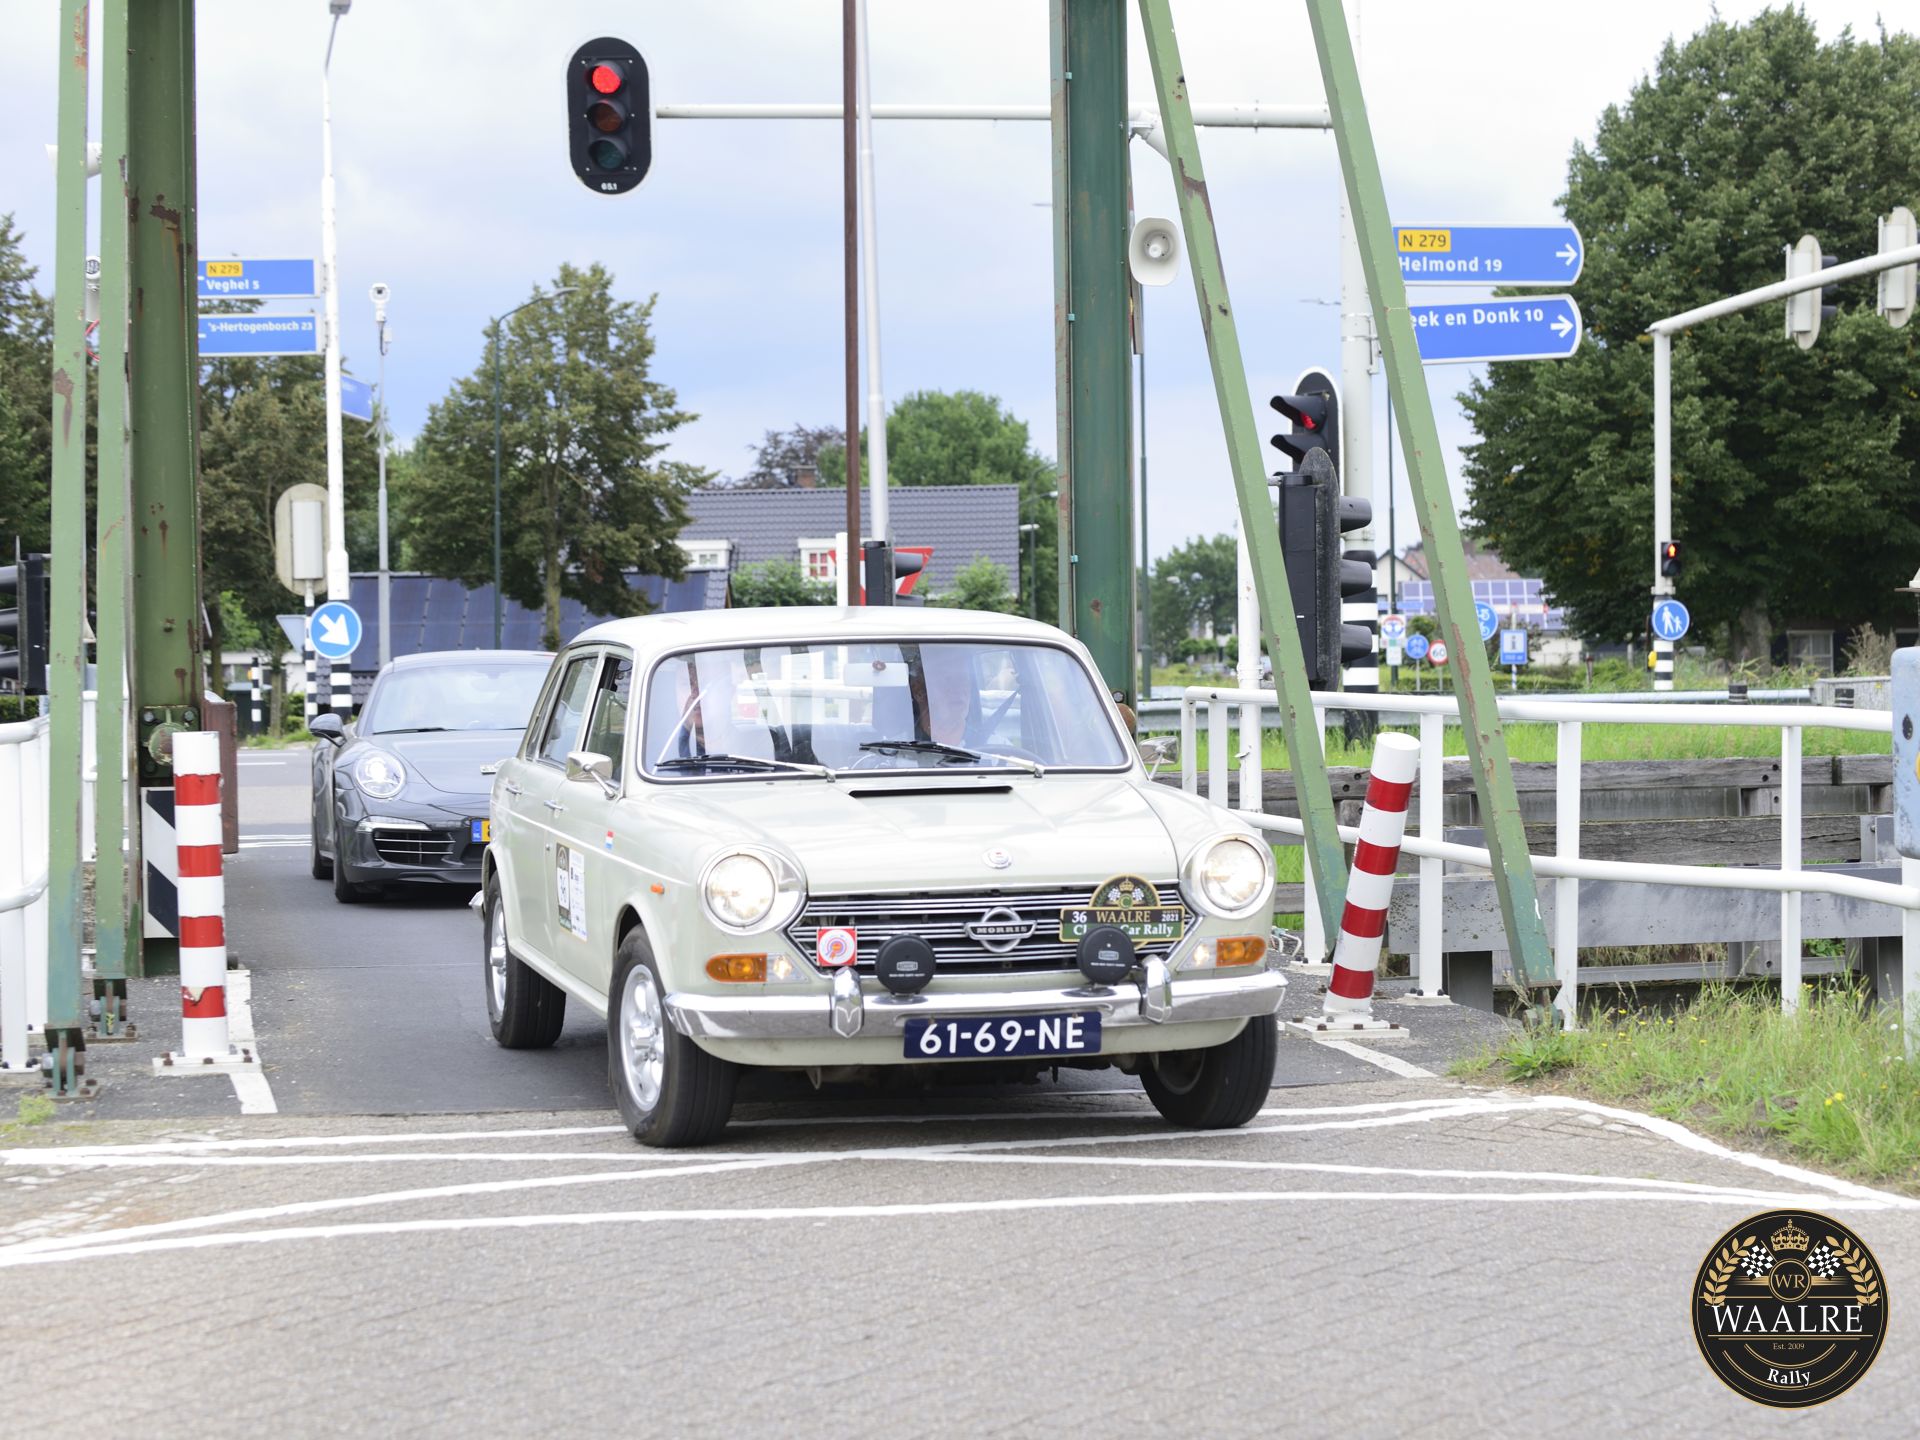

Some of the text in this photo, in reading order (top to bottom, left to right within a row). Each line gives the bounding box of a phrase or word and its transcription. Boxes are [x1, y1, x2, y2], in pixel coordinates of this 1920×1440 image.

[1403, 234, 1447, 248] N 279
[209, 264, 240, 274] N 279
[1398, 256, 1503, 272] Helmond 19
[206, 279, 260, 293] Veghel 5
[1410, 307, 1544, 327] eek en Donk 10
[208, 320, 313, 334] 's-Hertogenbosch 23
[1071, 910, 1179, 923] 36 WAALRE 2021
[976, 926, 1028, 934] MORRIS
[1120, 924, 1174, 938] Car Rally
[919, 1016, 1085, 1055] 61-69-NE
